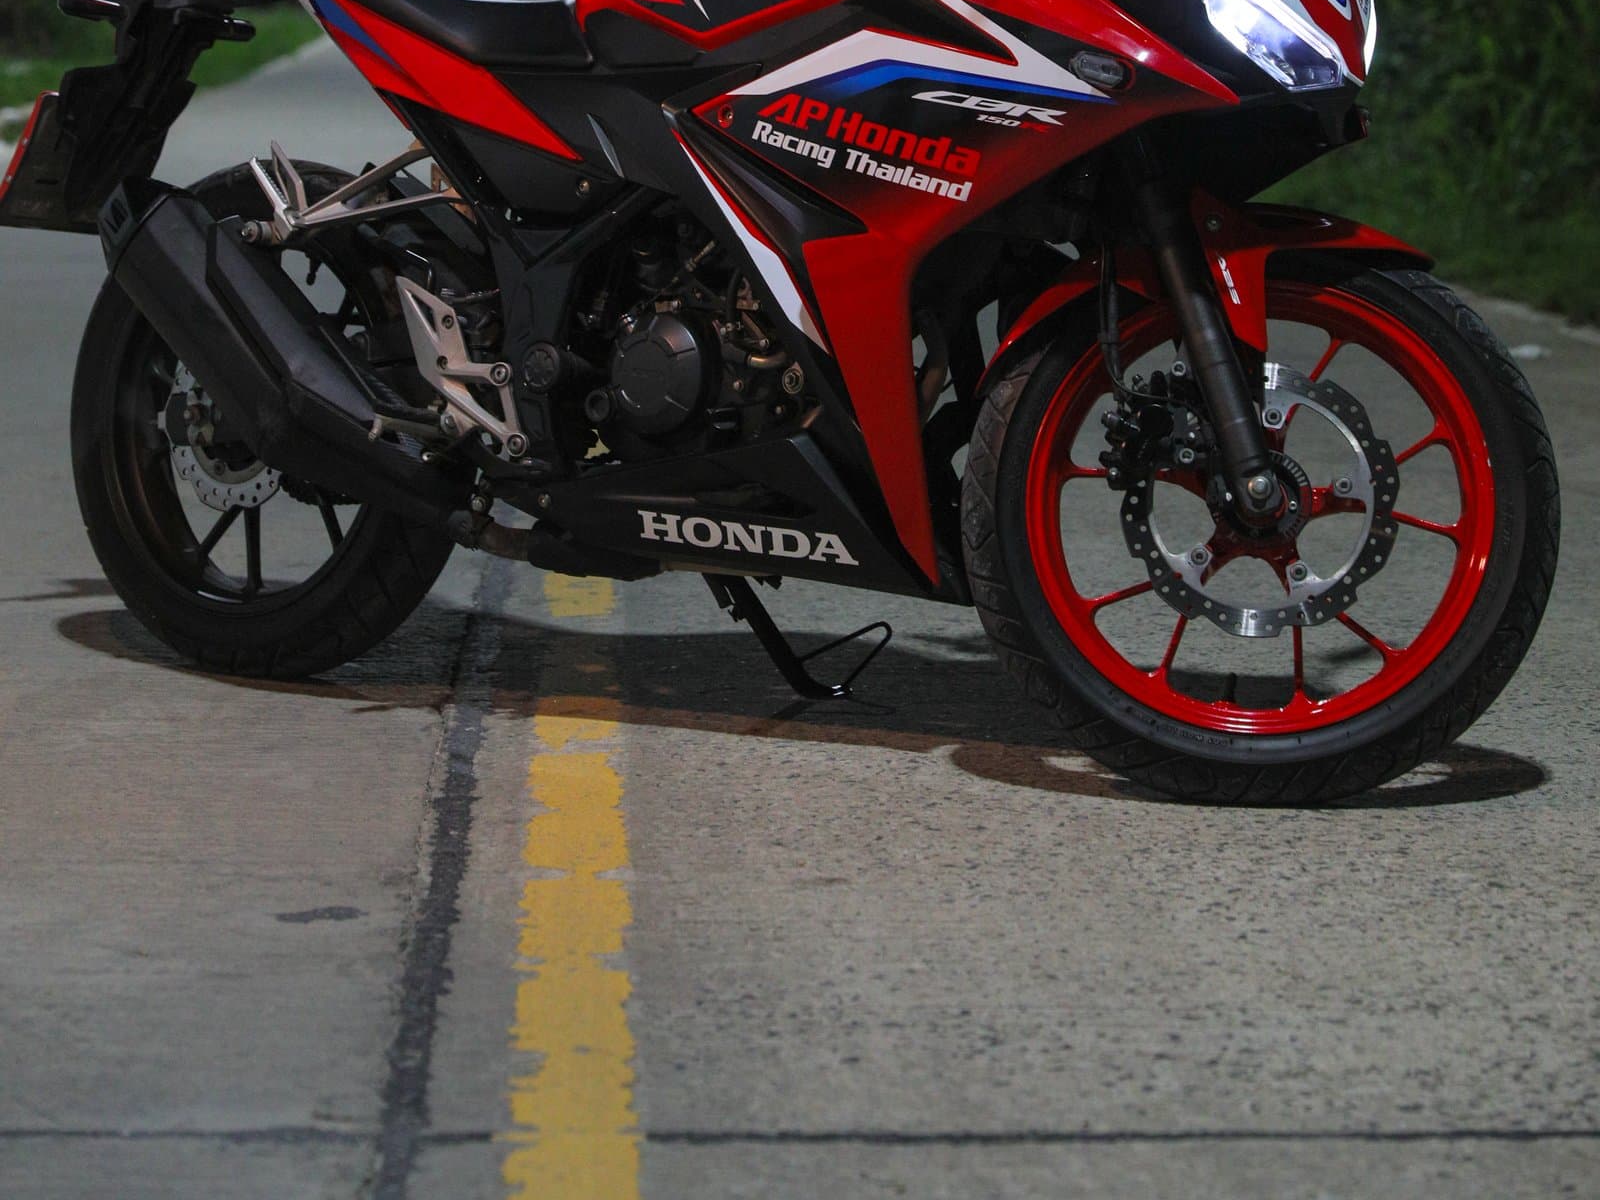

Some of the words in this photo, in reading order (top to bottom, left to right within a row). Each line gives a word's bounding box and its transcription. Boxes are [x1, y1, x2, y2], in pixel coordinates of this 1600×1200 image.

[911, 90, 1067, 126] CBR
[751, 120, 836, 169] Racing
[845, 148, 972, 202] Thailand
[826, 107, 982, 177] Honda
[637, 510, 859, 566] HONDA
